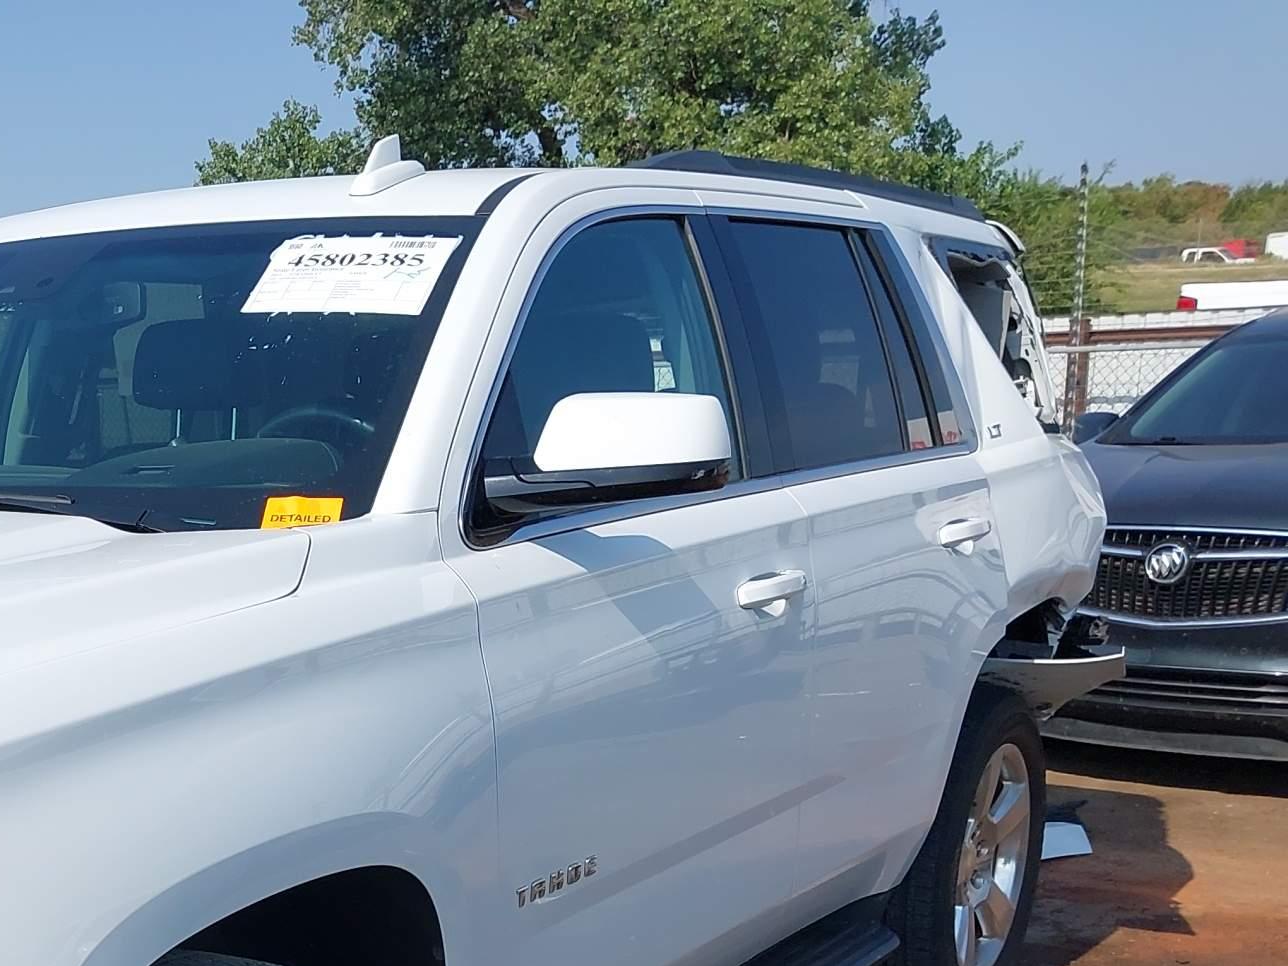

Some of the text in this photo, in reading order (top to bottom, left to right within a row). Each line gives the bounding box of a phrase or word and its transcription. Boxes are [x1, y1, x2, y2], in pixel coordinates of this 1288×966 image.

[288, 253, 425, 267] 45802385
[270, 514, 331, 523] DETAILED
[516, 855, 597, 908] TAHOE
